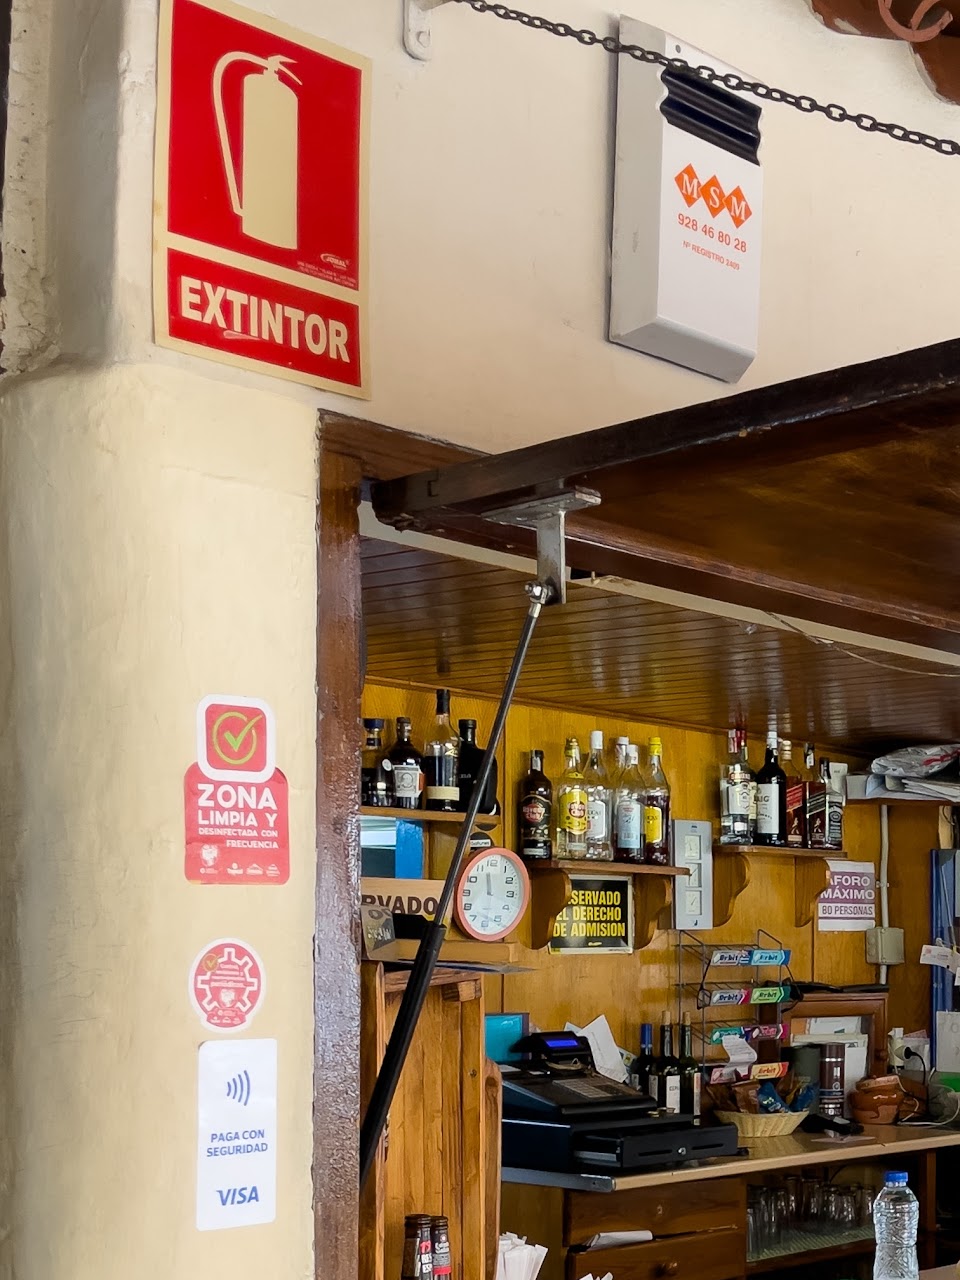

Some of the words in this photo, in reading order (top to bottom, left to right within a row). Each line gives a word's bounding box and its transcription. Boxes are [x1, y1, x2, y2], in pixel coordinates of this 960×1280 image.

[680, 170, 748, 222] MSM
[678, 213, 698, 231] 928
[701, 224, 715, 239] 46
[717, 230, 731, 246] 80
[734, 238, 747, 253] 28
[691, 244, 725, 264] REGISTRO
[180, 275, 351, 363] EXTINTOR
[197, 783, 278, 810] ZONA
[197, 809, 258, 827] LIMPIA
[265, 812, 278, 828] Y
[198, 827, 258, 838] DESINFECTADA
[261, 829, 278, 838] CON
[226, 839, 279, 849] FRECUENCIA
[830, 875, 871, 887] FORO
[568, 889, 622, 906] SERVADO
[820, 886, 875, 900] MÁXIMO
[573, 906, 622, 921] DERECHO
[822, 905, 833, 915] 80
[834, 905, 873, 916] PERSONAS
[552, 922, 568, 937] DE
[570, 922, 626, 937] ADMISION
[210, 1131, 240, 1144] PAGA
[242, 1129, 265, 1141] CON
[206, 1142, 268, 1157] SEGURIDAD
[216, 1185, 260, 1206] VISA
